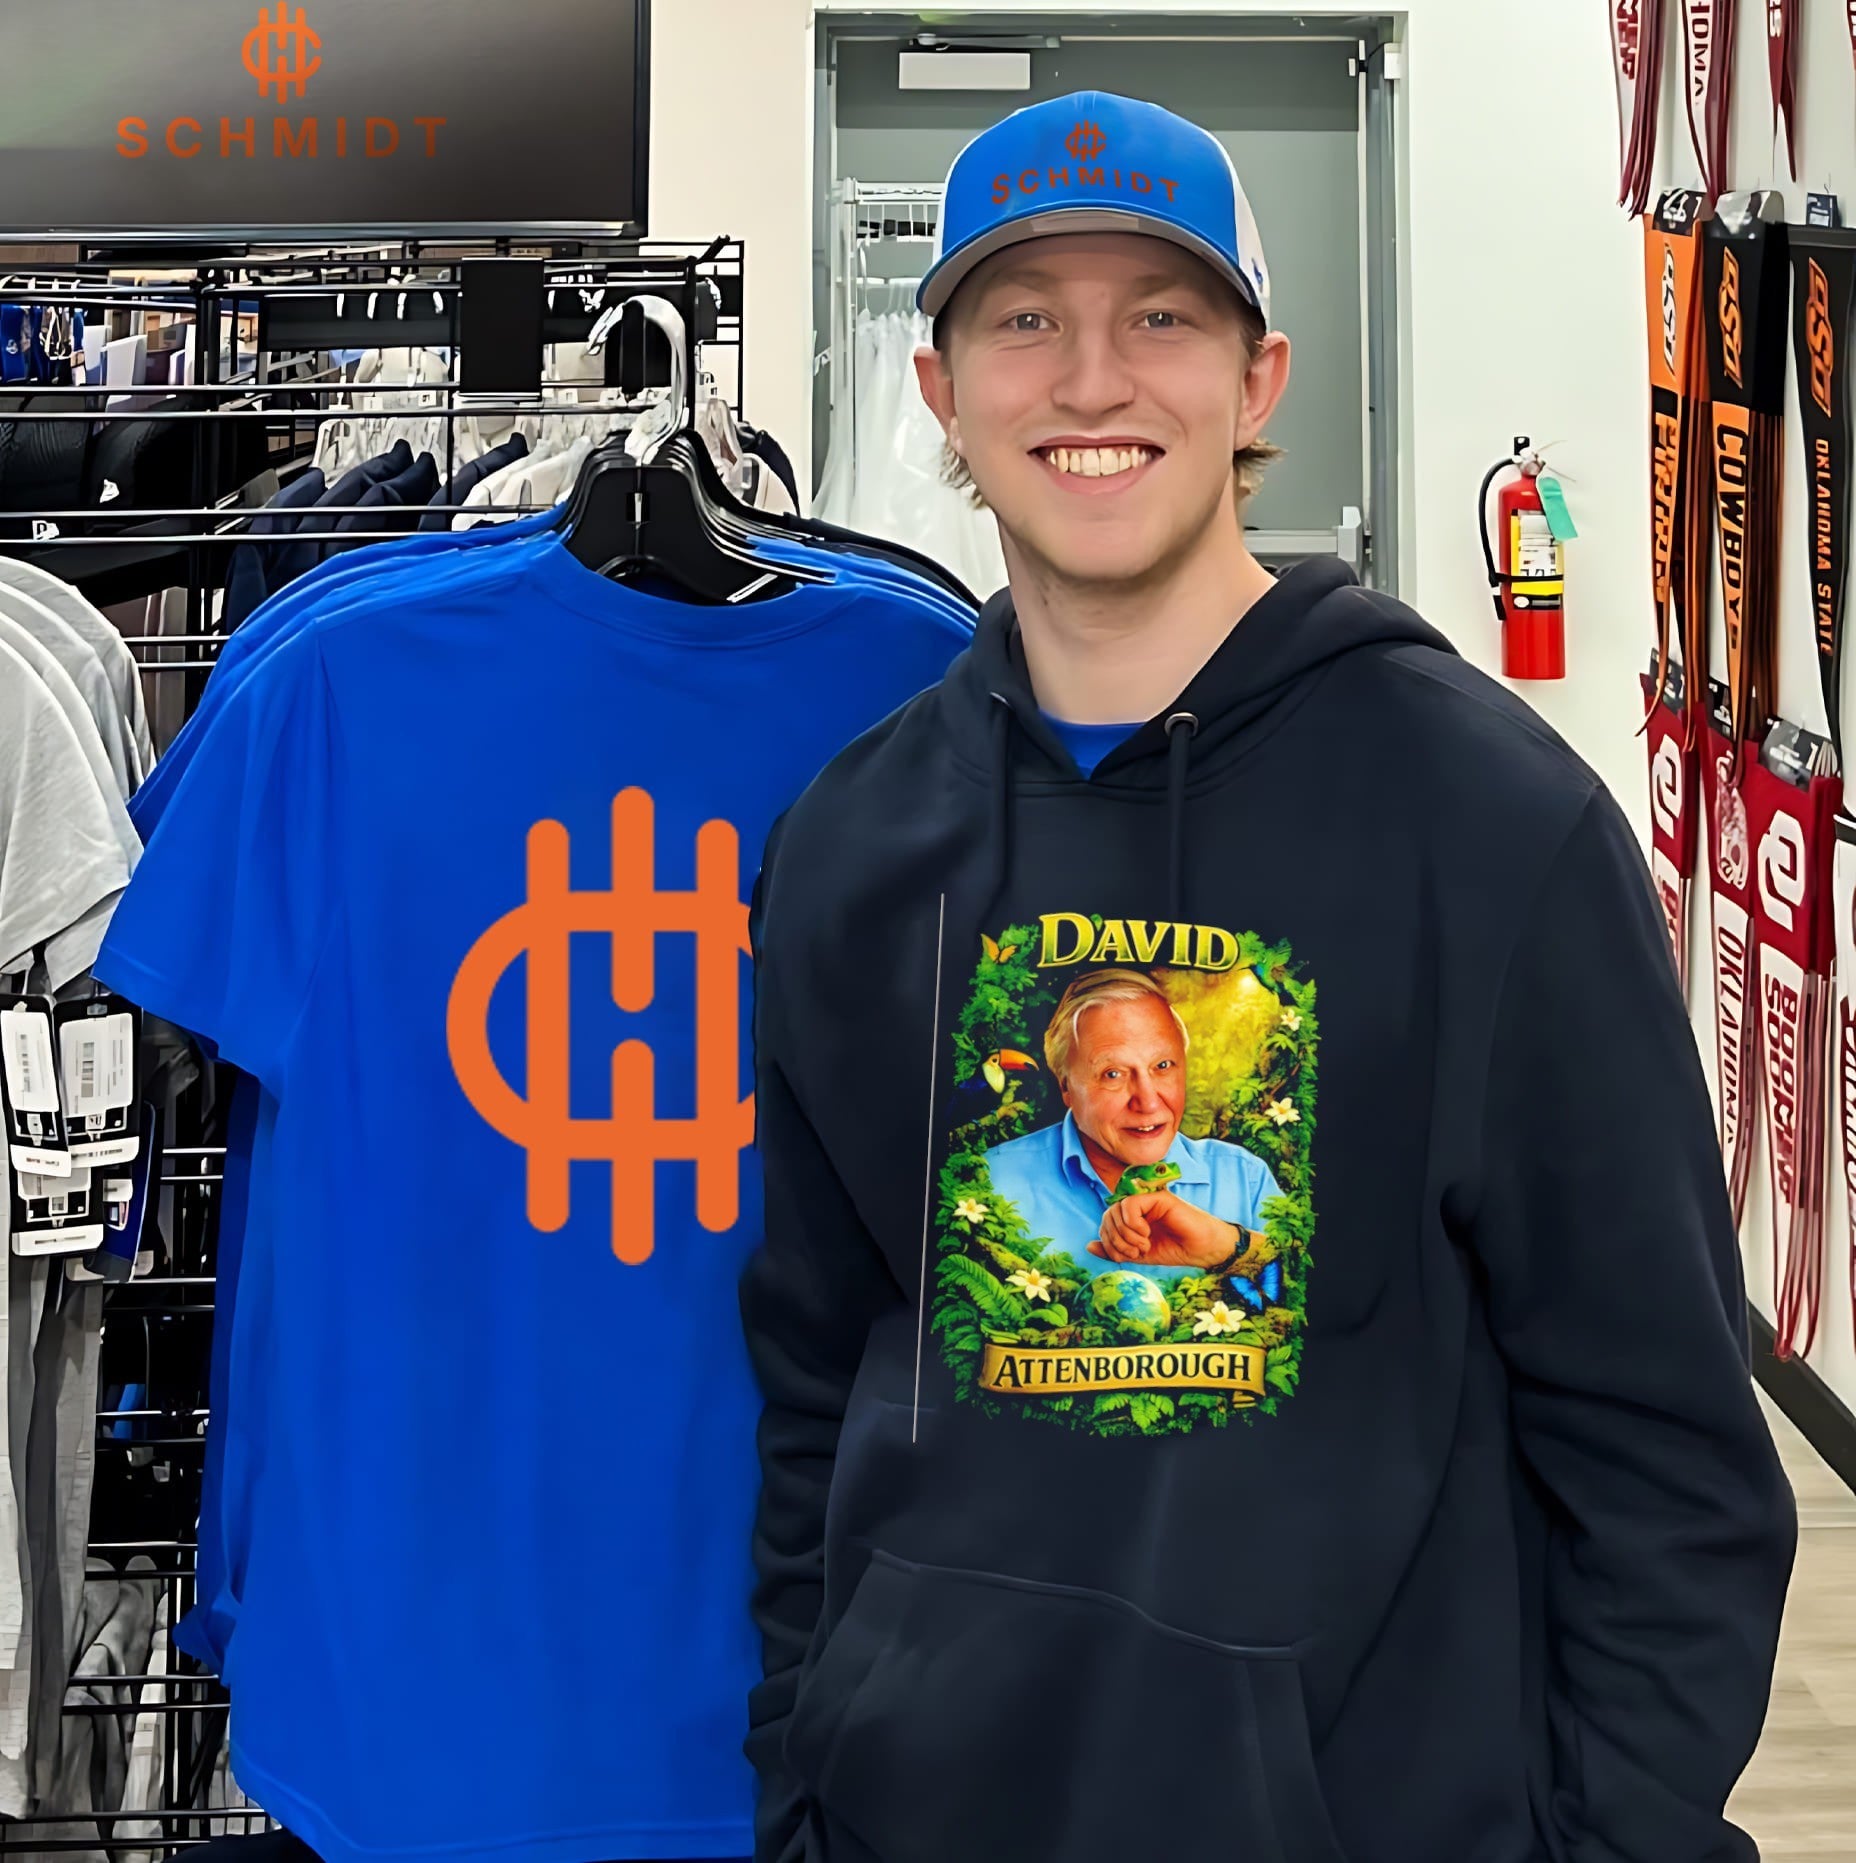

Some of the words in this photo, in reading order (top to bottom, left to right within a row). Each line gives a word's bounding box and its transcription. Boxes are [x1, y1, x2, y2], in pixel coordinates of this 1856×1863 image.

[115, 116, 448, 158] SCHMIDT
[991, 167, 1179, 205] SCHMIDT
[1815, 438, 1832, 570] OKLAHOMA
[1037, 911, 1240, 973] DAVID
[1718, 925, 1746, 1144] OKLAHOMA
[991, 1352, 1252, 1389] ATTENBOROUGH
